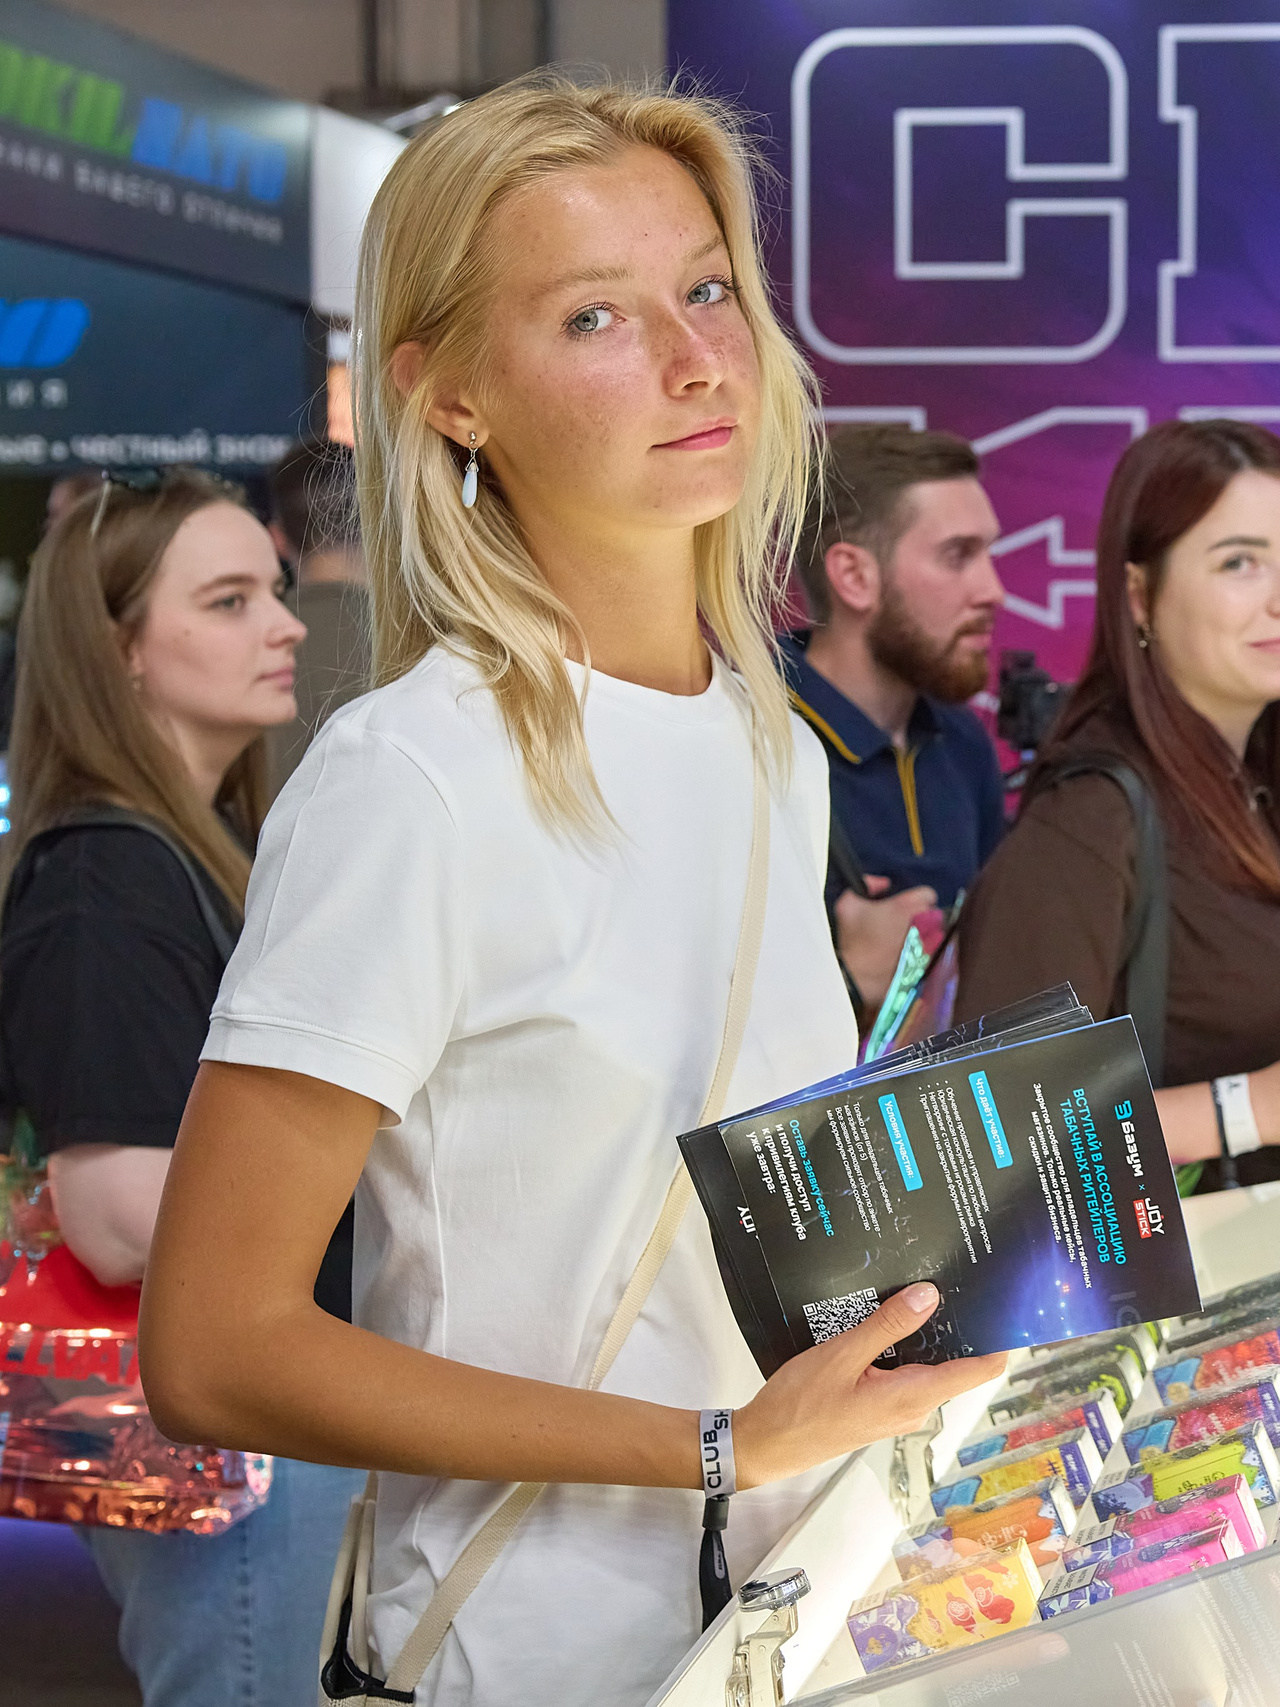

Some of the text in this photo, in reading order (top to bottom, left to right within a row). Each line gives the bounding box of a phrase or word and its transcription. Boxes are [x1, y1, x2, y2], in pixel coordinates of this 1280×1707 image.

[746, 1131, 776, 1195] уже завтра:
[778, 1131, 797, 1172] получи
[791, 1172, 810, 1212] доступ
[834, 1106, 844, 1120] Все
[839, 1120, 851, 1144] заявки
[847, 1144, 861, 1177] проходят
[858, 1176, 869, 1198] отбор
[868, 1207, 881, 1232] анкете
[844, 1104, 858, 1141] магазинов
[854, 1141, 865, 1153] (от
[853, 1102, 893, 1214] Только для владельцев табачных
[884, 1100, 914, 1178] Условия участия:
[928, 1091, 946, 1132] Нетворкинг
[944, 1137, 958, 1172] топовыми
[954, 1172, 968, 1205] игроками
[964, 1205, 975, 1227] рынка
[936, 1089, 956, 1136] Юридическая
[952, 1136, 971, 1184] консультация
[970, 1193, 982, 1218] любым
[978, 1218, 992, 1254] вопросам
[945, 1086, 961, 1121] Обучение
[956, 1120, 973, 1159] продавцов
[970, 1164, 989, 1212] управляющих
[974, 1078, 1004, 1158] Что даёт участие:
[763, 1134, 794, 1206] привилегиям
[789, 1207, 806, 1240] клуба
[789, 1118, 834, 1237] Оставь заявку сейчас
[829, 1120, 847, 1160] формируем
[843, 1160, 856, 1188] сильное
[852, 1188, 870, 1231] сообщество
[918, 1093, 938, 1140] Приглашения
[937, 1150, 952, 1183] закрытые
[947, 1183, 961, 1211] форумы
[959, 1216, 977, 1264] мероприятия
[1028, 1135, 1041, 1165] скидки
[1039, 1173, 1051, 1204] защита
[1048, 1204, 1061, 1243] бизнеса.
[1031, 1110, 1076, 1263] магазинов. Только реальные кейсы,
[1033, 1082, 1090, 1288] Закрытое сообщество для владельцев табачных
[1059, 1098, 1110, 1263] ТАБАЧНЫХ РИТЕЙЛЕРОВ
[1073, 1088, 1101, 1151] ВСТУПАЙ
[1093, 1163, 1125, 1265] АССОЦИАЦИЮ
[1121, 1120, 1143, 1178] Базум
[1144, 1195, 1166, 1236] JOY
[1135, 1201, 1148, 1235] STICK
[703, 1429, 721, 1489] CLUB
